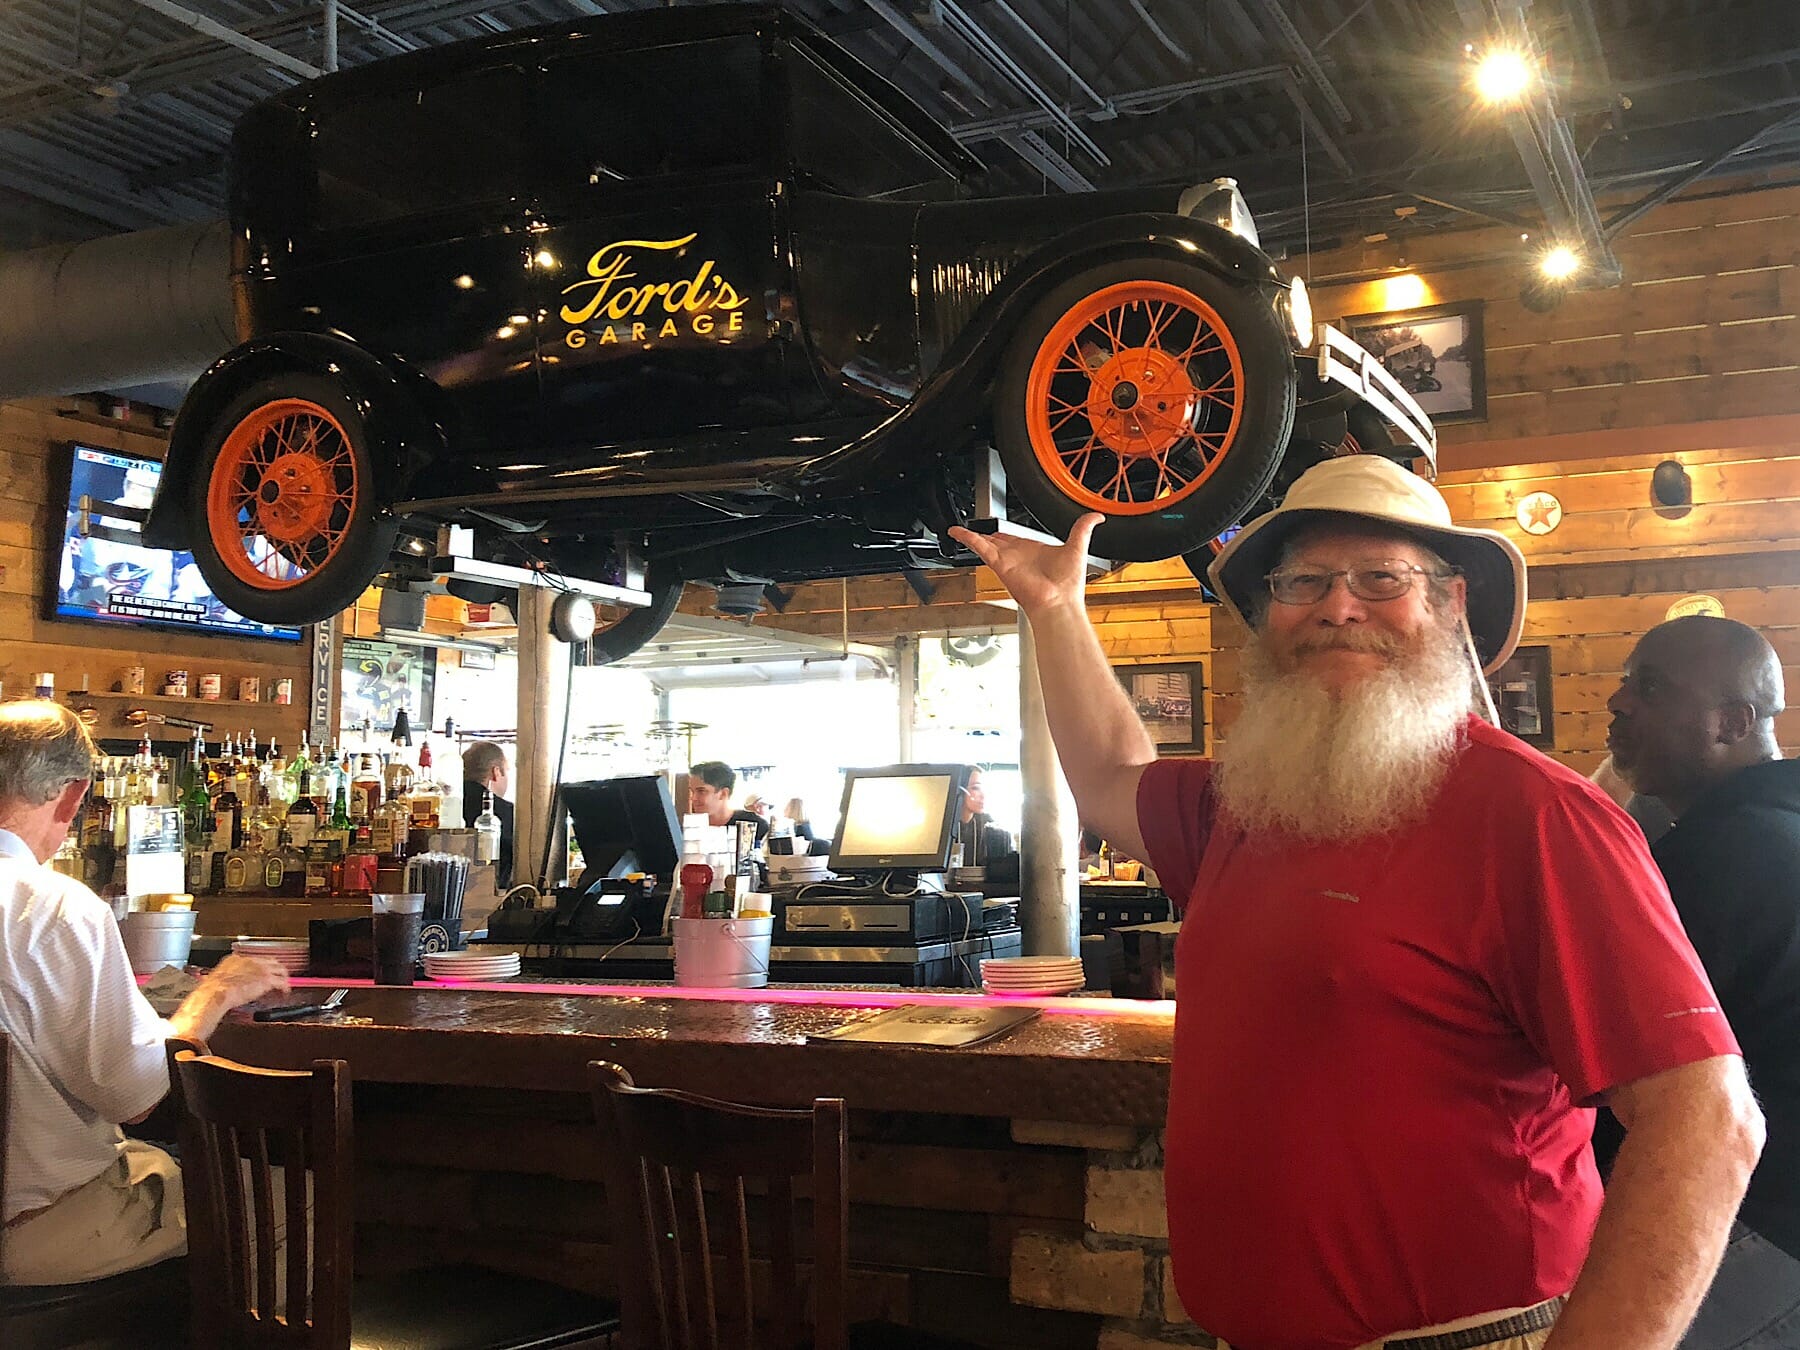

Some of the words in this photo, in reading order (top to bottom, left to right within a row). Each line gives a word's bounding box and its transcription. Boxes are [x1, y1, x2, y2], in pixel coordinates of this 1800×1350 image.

[560, 233, 749, 324] Ford's
[566, 311, 743, 349] GARAGE
[317, 620, 329, 720] ERVICE
